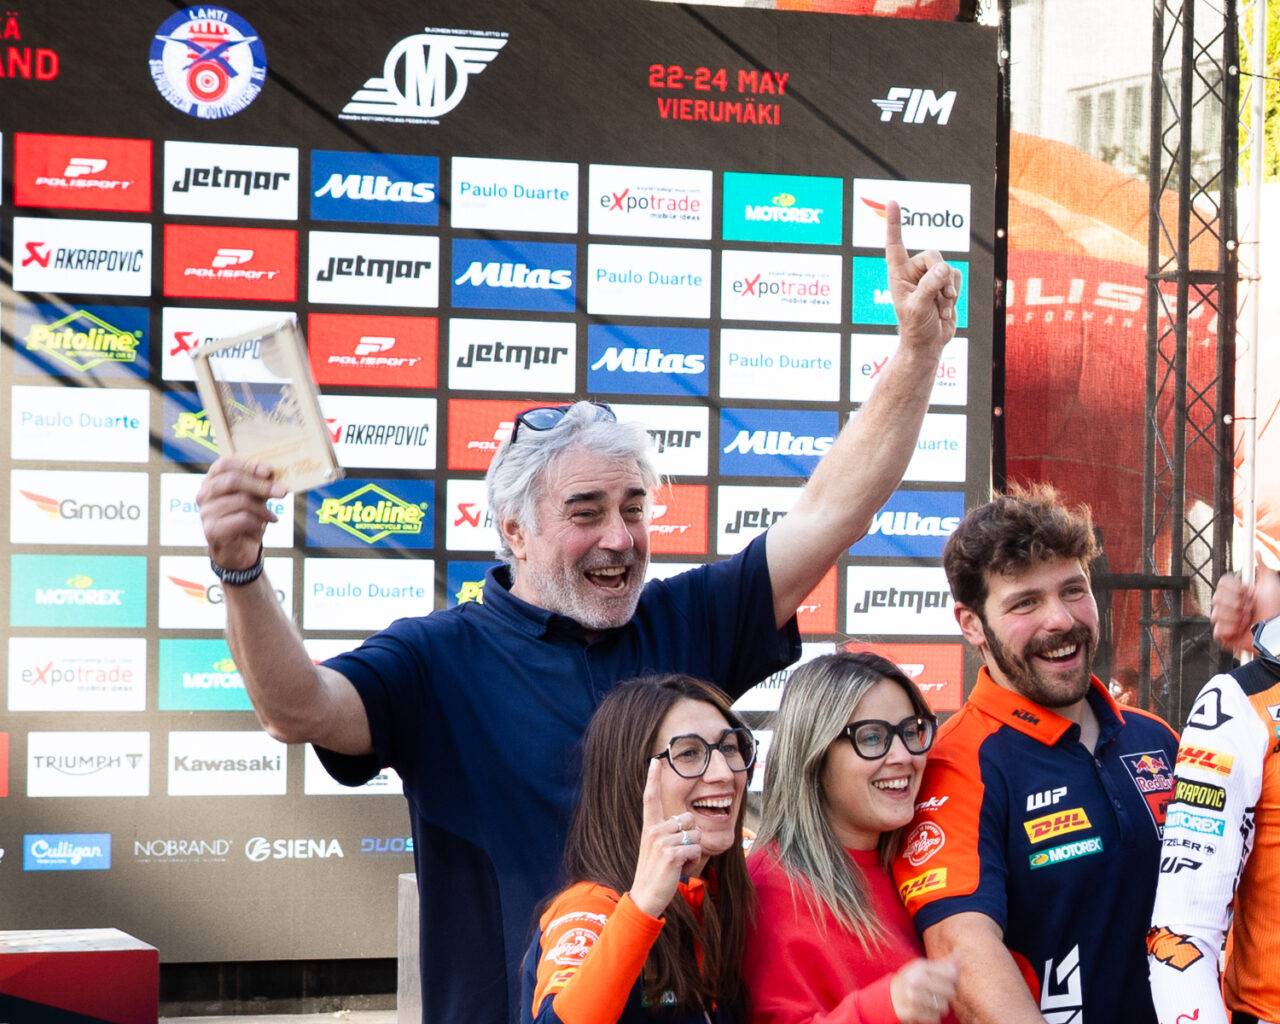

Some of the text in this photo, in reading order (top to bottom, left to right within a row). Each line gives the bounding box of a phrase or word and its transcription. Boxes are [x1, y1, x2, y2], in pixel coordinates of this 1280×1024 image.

[189, 8, 228, 22] LAHTI
[648, 64, 789, 95] 22-24 MAY
[657, 97, 781, 126] VIERUMÄKI
[872, 86, 957, 126] FIM
[35, 177, 133, 190] POLISPORT
[173, 166, 290, 195] jetmar
[314, 174, 435, 203] Mitas
[460, 181, 569, 200] Paulo Duarte
[746, 205, 821, 224] MOTOREX
[900, 207, 963, 228] Gmoto
[54, 248, 143, 273] AKRAPOVIČ
[317, 255, 431, 284] jetmar
[184, 267, 280, 281] POLISPORT
[455, 262, 572, 290] Mitas
[596, 268, 702, 287] Paulo Duarte
[27, 325, 137, 351] Putoline
[328, 355, 421, 369] POLISPORT
[457, 342, 568, 369] jetmar
[591, 347, 705, 374] Mitas
[728, 353, 832, 370] Paulo Duarte
[21, 411, 140, 429] Paulo Duarte
[345, 424, 429, 446] AKRAPOVIČ
[724, 431, 834, 456] Mitas
[917, 439, 958, 451] uarte
[60, 500, 140, 520] Gmoto
[318, 501, 424, 525] Putoline
[35, 589, 122, 605] MOTOREX
[313, 583, 425, 599] Paulo Duarte
[855, 588, 950, 613] jetmar
[183, 673, 246, 689] MOTOR
[1012, 709, 1040, 726] KTM
[33, 755, 121, 774] TRIUMPH
[174, 756, 281, 771] Kawasaki
[1027, 787, 1067, 811] WP
[1177, 783, 1225, 808] RAPOVIČ
[1029, 812, 1087, 838] DHL
[31, 840, 102, 865] Culligan
[134, 840, 230, 857] NOBRAND
[273, 839, 344, 858] SIENA
[1050, 838, 1101, 861] MOTOREX
